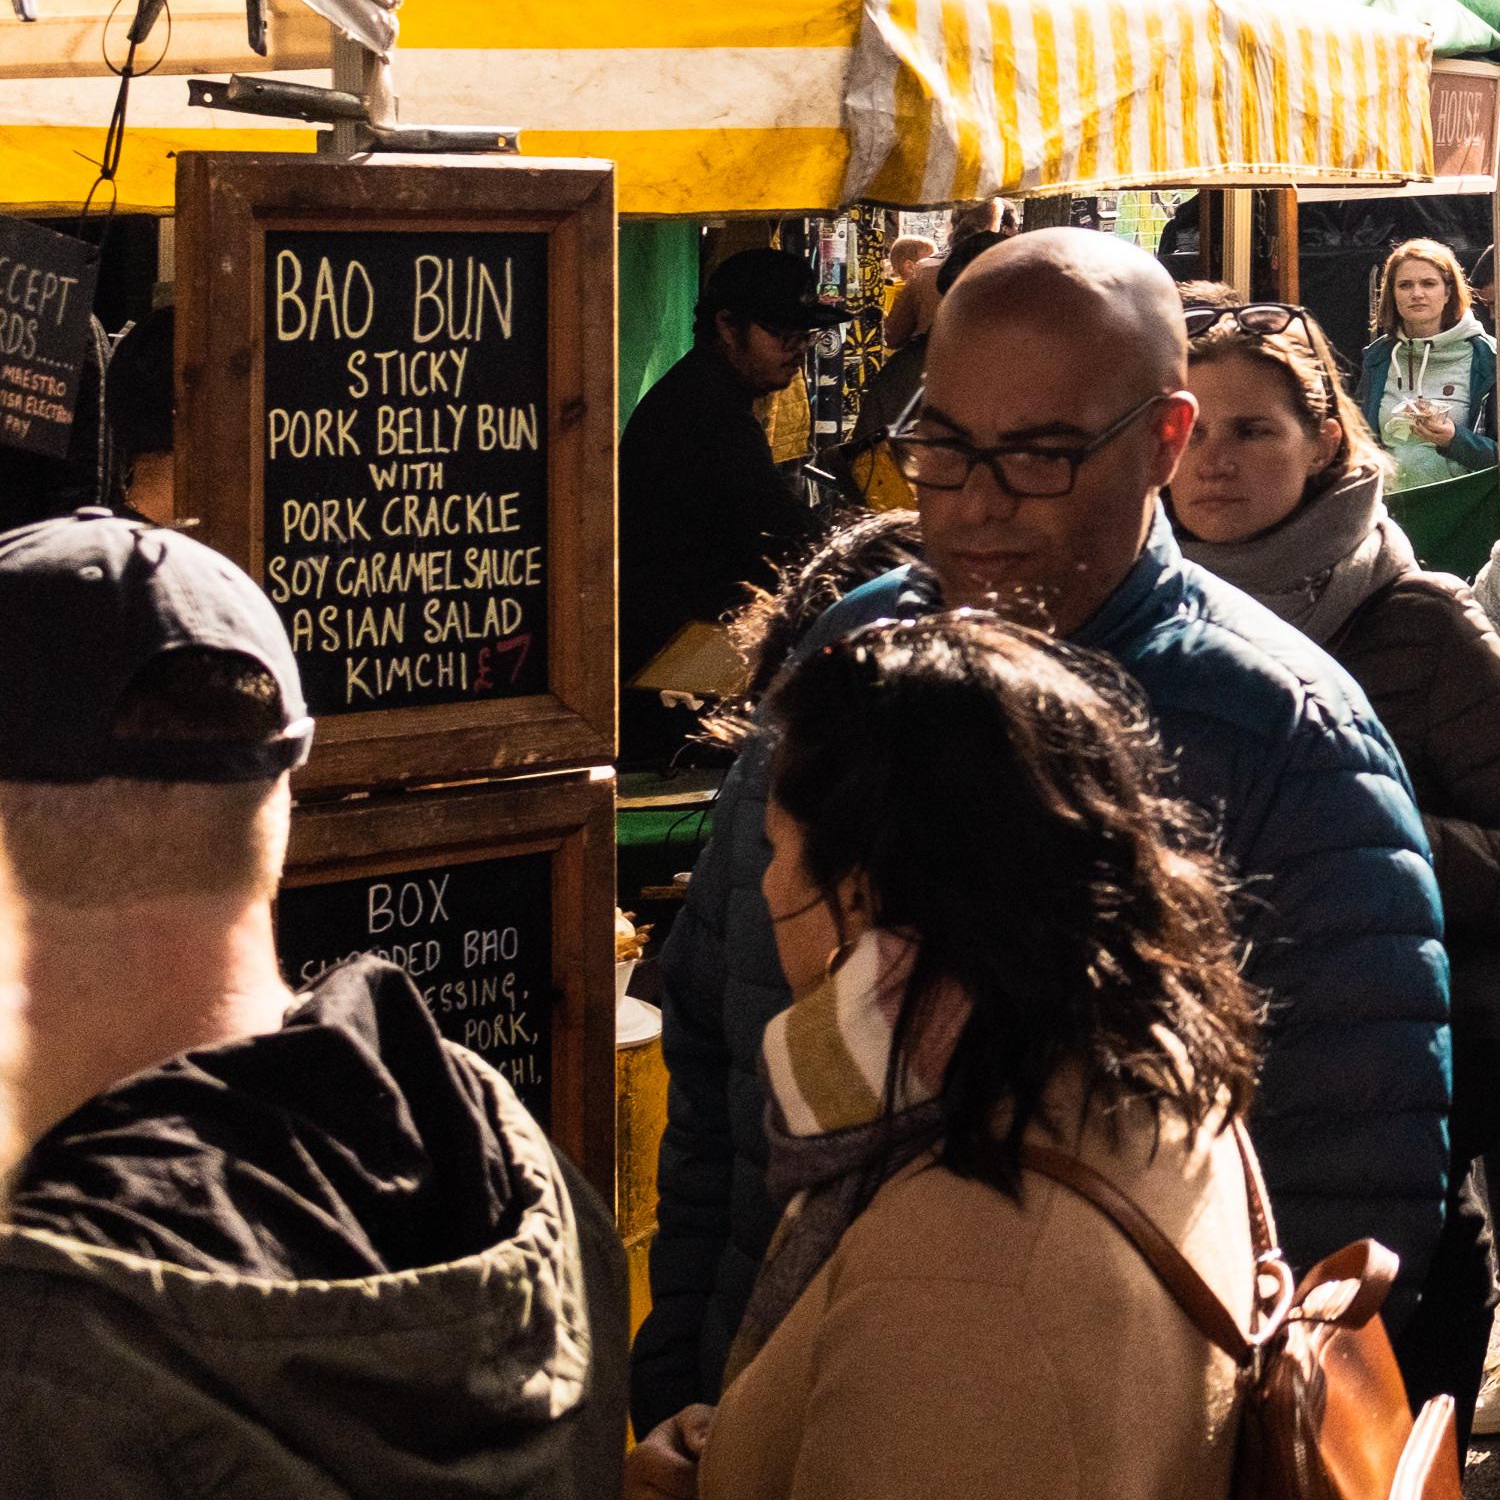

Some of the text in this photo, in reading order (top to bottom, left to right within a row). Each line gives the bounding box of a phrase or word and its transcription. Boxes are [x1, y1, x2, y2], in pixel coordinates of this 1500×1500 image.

[1436, 90, 1484, 147] HOUSE
[276, 248, 513, 344] BAO BUN
[347, 348, 469, 399] STICKY
[268, 402, 539, 460] PORK BELLY BUN
[368, 460, 444, 492] WITH
[283, 492, 521, 544] PORK CRACKLE
[268, 545, 542, 603] SOY CARAMEL SAUCE
[291, 596, 522, 653] ASIAN SALAD
[345, 631, 532, 704] KIMCHI £7
[367, 873, 450, 934] BOX
[463, 926, 518, 969] BAO
[423, 971, 529, 1014] ESSING,
[465, 1011, 540, 1051] PORK,
